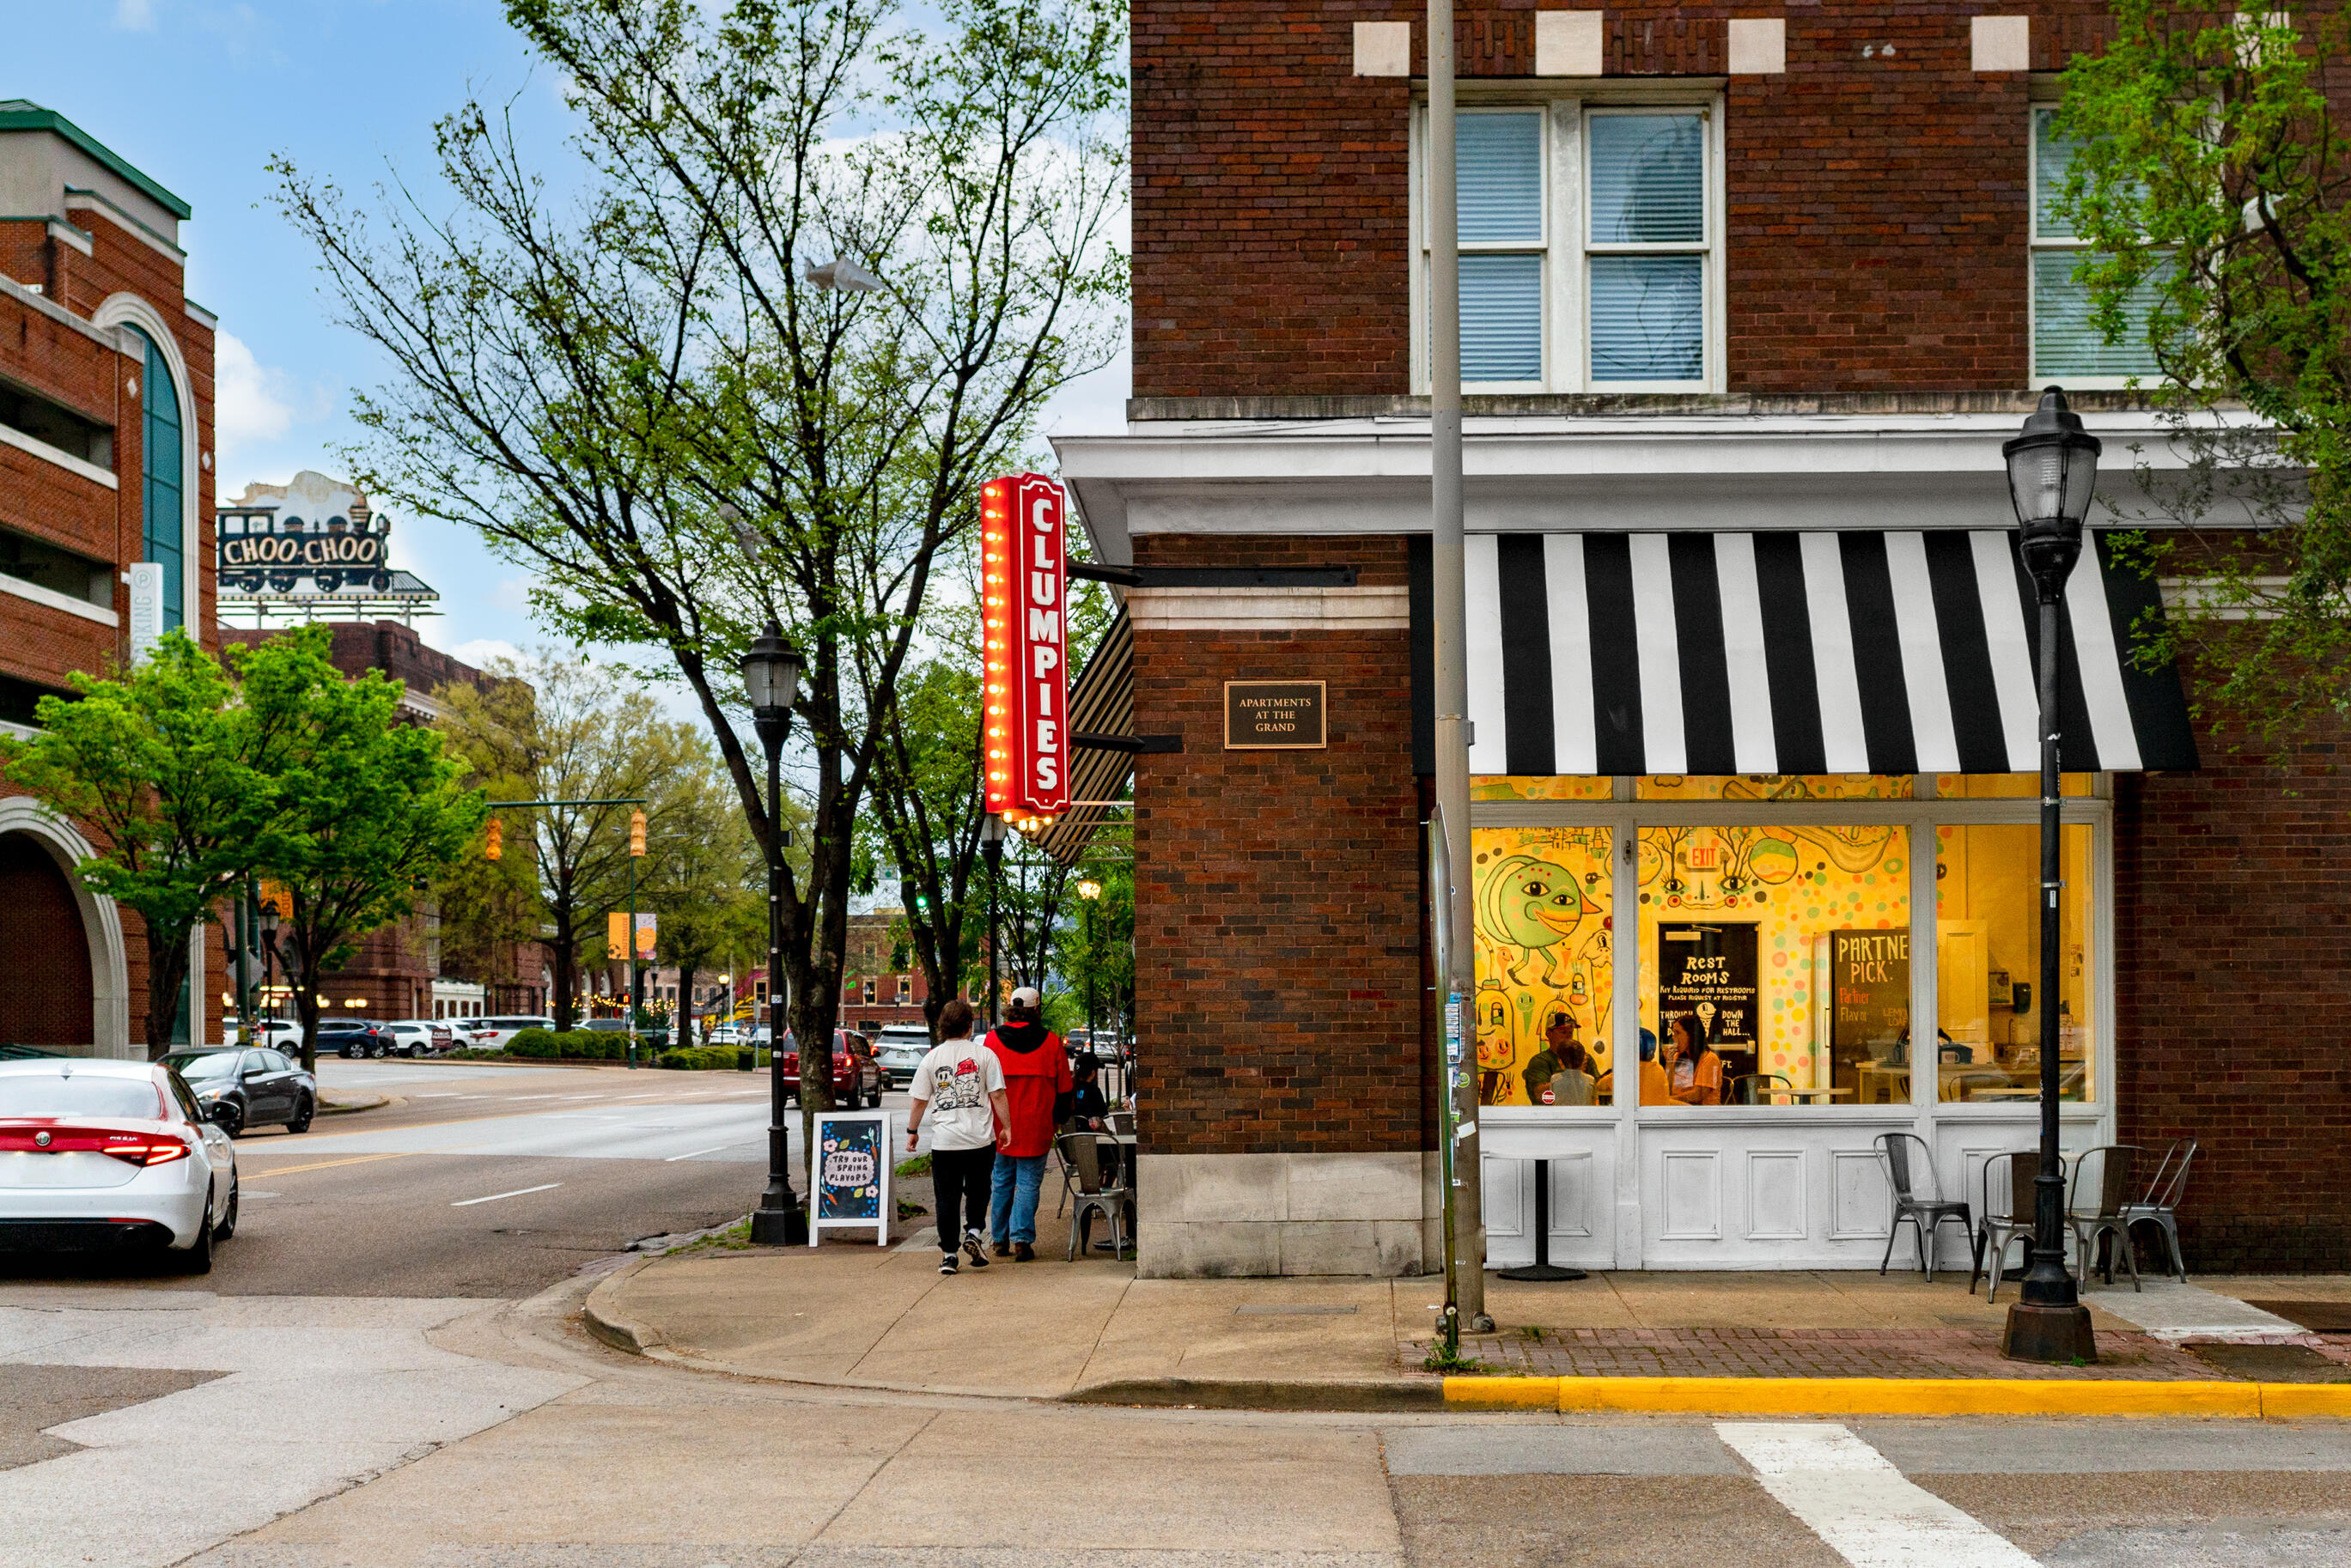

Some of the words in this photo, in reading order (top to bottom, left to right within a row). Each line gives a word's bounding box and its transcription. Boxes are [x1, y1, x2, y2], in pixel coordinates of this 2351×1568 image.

[223, 536, 377, 564] CHOO-CHOO
[1029, 498, 1059, 790] CLUMPIES
[1239, 698, 1311, 708] APARTMENTS
[1256, 723, 1295, 732] GRAND
[1692, 848, 1715, 866] EXIT
[1839, 935, 1908, 962] PARTNE
[1851, 961, 1893, 984] PICK:
[1721, 1010, 1744, 1019] DOWN
[1725, 1019, 1739, 1028] THE
